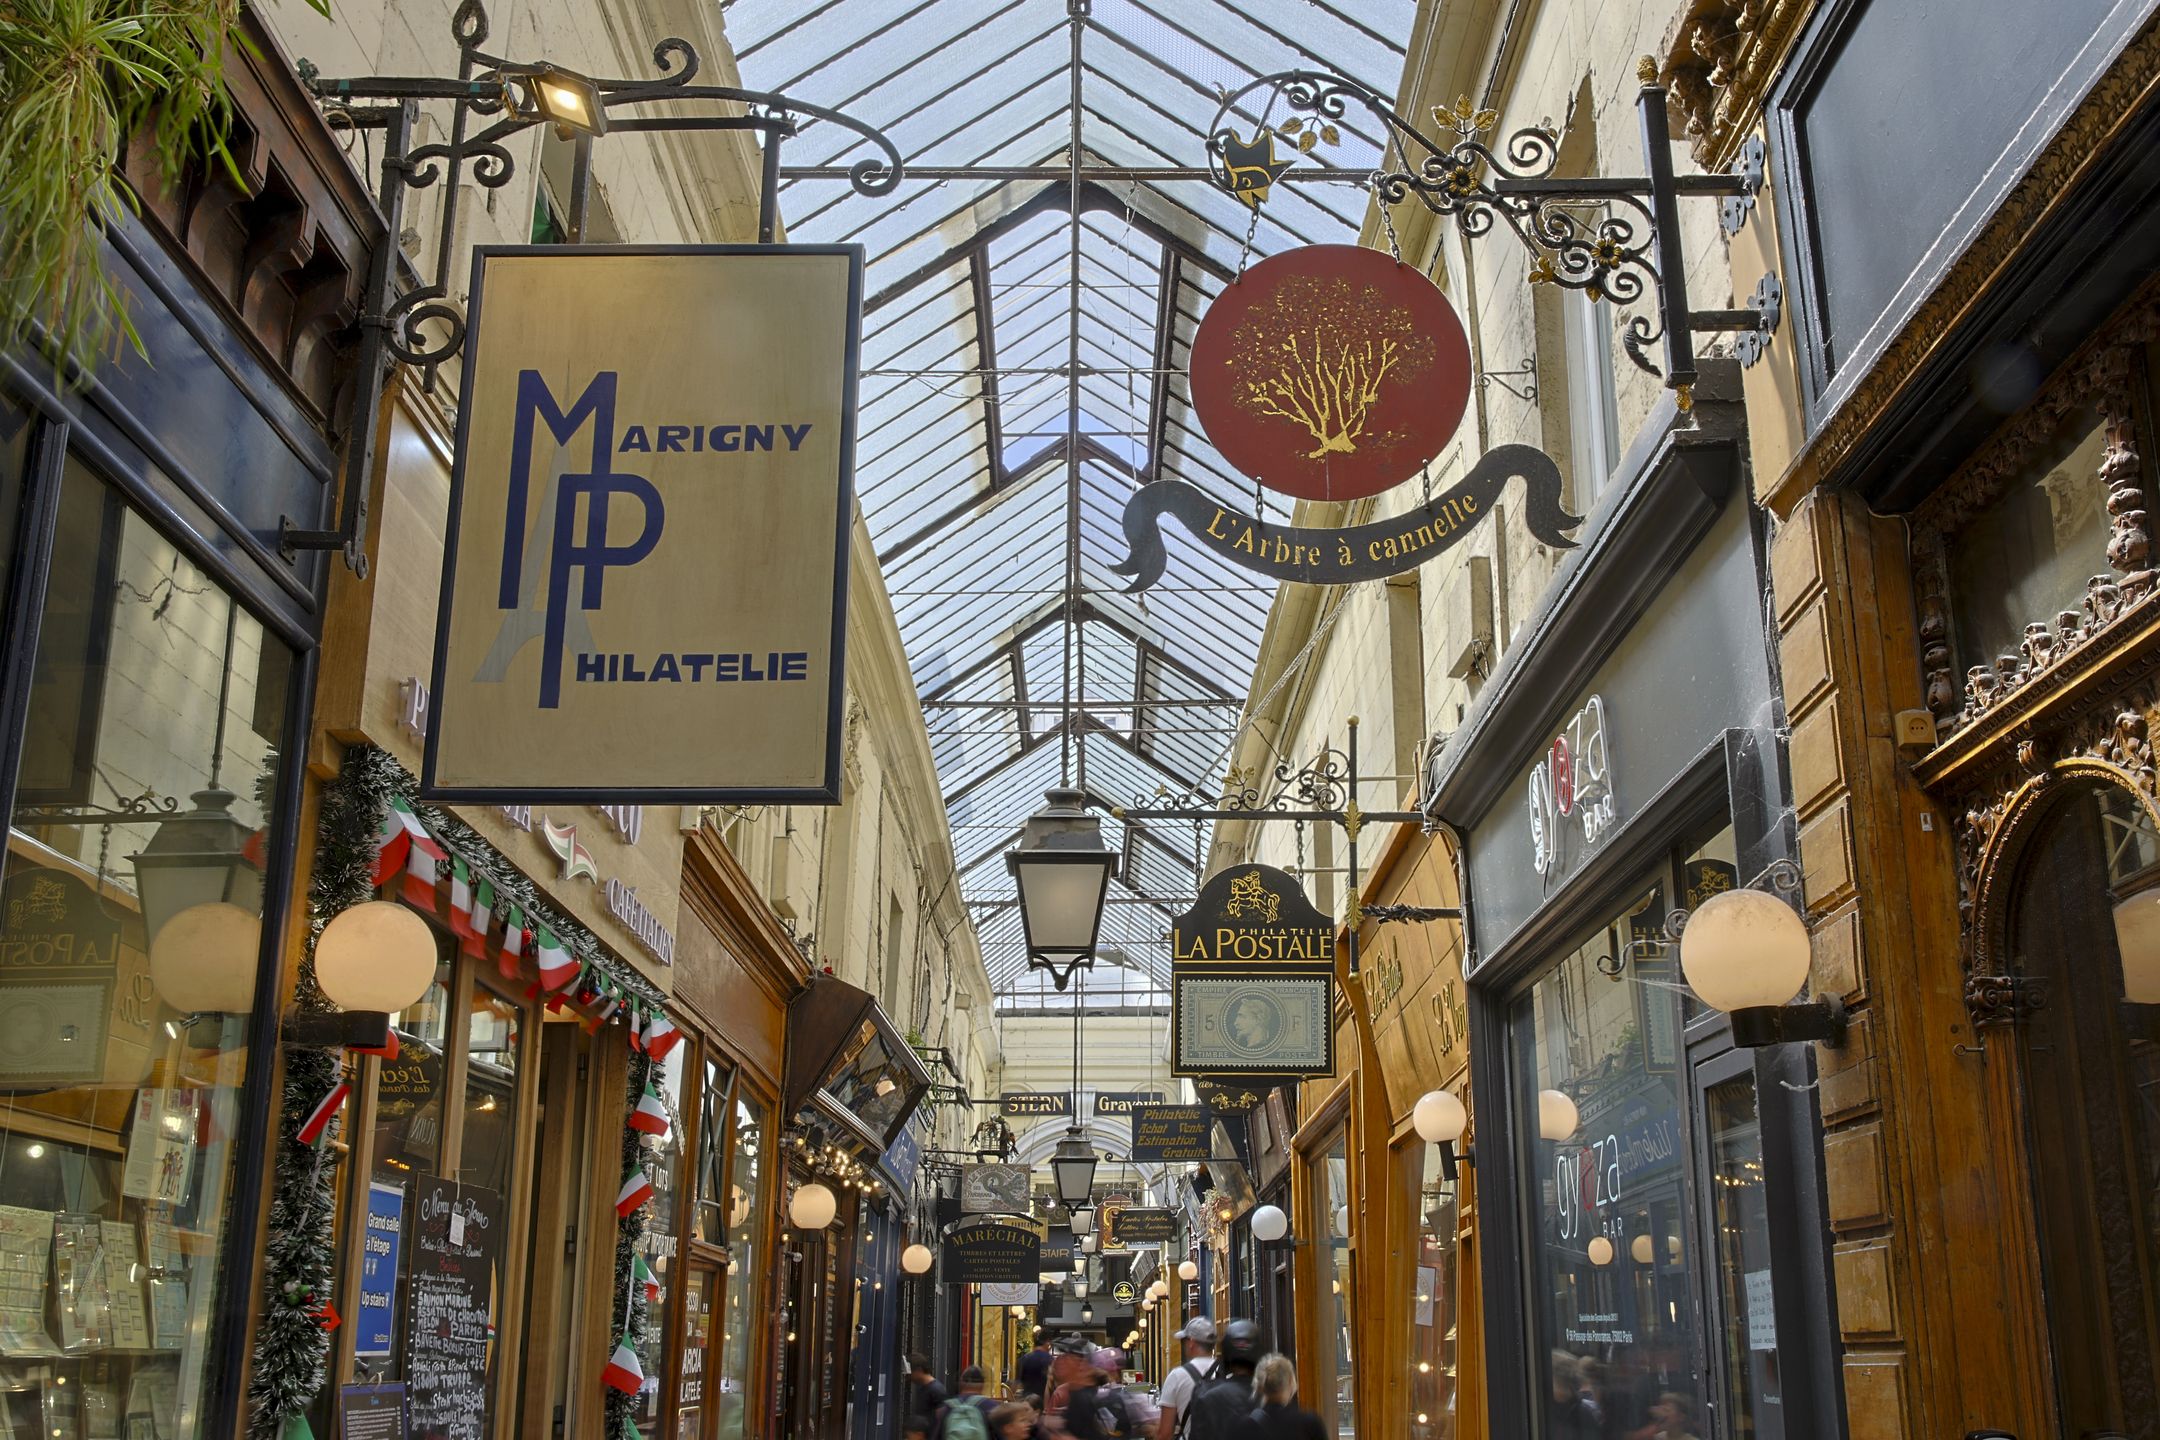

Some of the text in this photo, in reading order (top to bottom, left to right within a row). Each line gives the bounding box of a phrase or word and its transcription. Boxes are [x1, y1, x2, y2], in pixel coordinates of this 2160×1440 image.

[1206, 491, 1479, 566] L'Arbre à cannelle
[1529, 694, 1614, 874] gyoza
[1583, 794, 1616, 843] BAR
[639, 903, 675, 968] ITALIEN
[1175, 928, 1332, 960] LA POSTALE
[1205, 1014, 1301, 1031] 5 F
[1008, 1096, 1064, 1112] STERN
[1143, 1109, 1200, 1119] Philatélie
[1139, 1122, 1205, 1134] Achat Vente
[1137, 1135, 1197, 1146] Estimation
[1162, 1147, 1208, 1158] Gratuite
[1557, 1134, 1621, 1240] gyoza
[421, 1188, 450, 1221] Menu
[367, 1212, 399, 1232] Grand salle
[1602, 1217, 1623, 1239] BAR
[952, 1226, 1035, 1249] MARÉCHAL
[361, 1290, 385, 1307] Up stairs
[451, 1321, 483, 1338] PARMA
